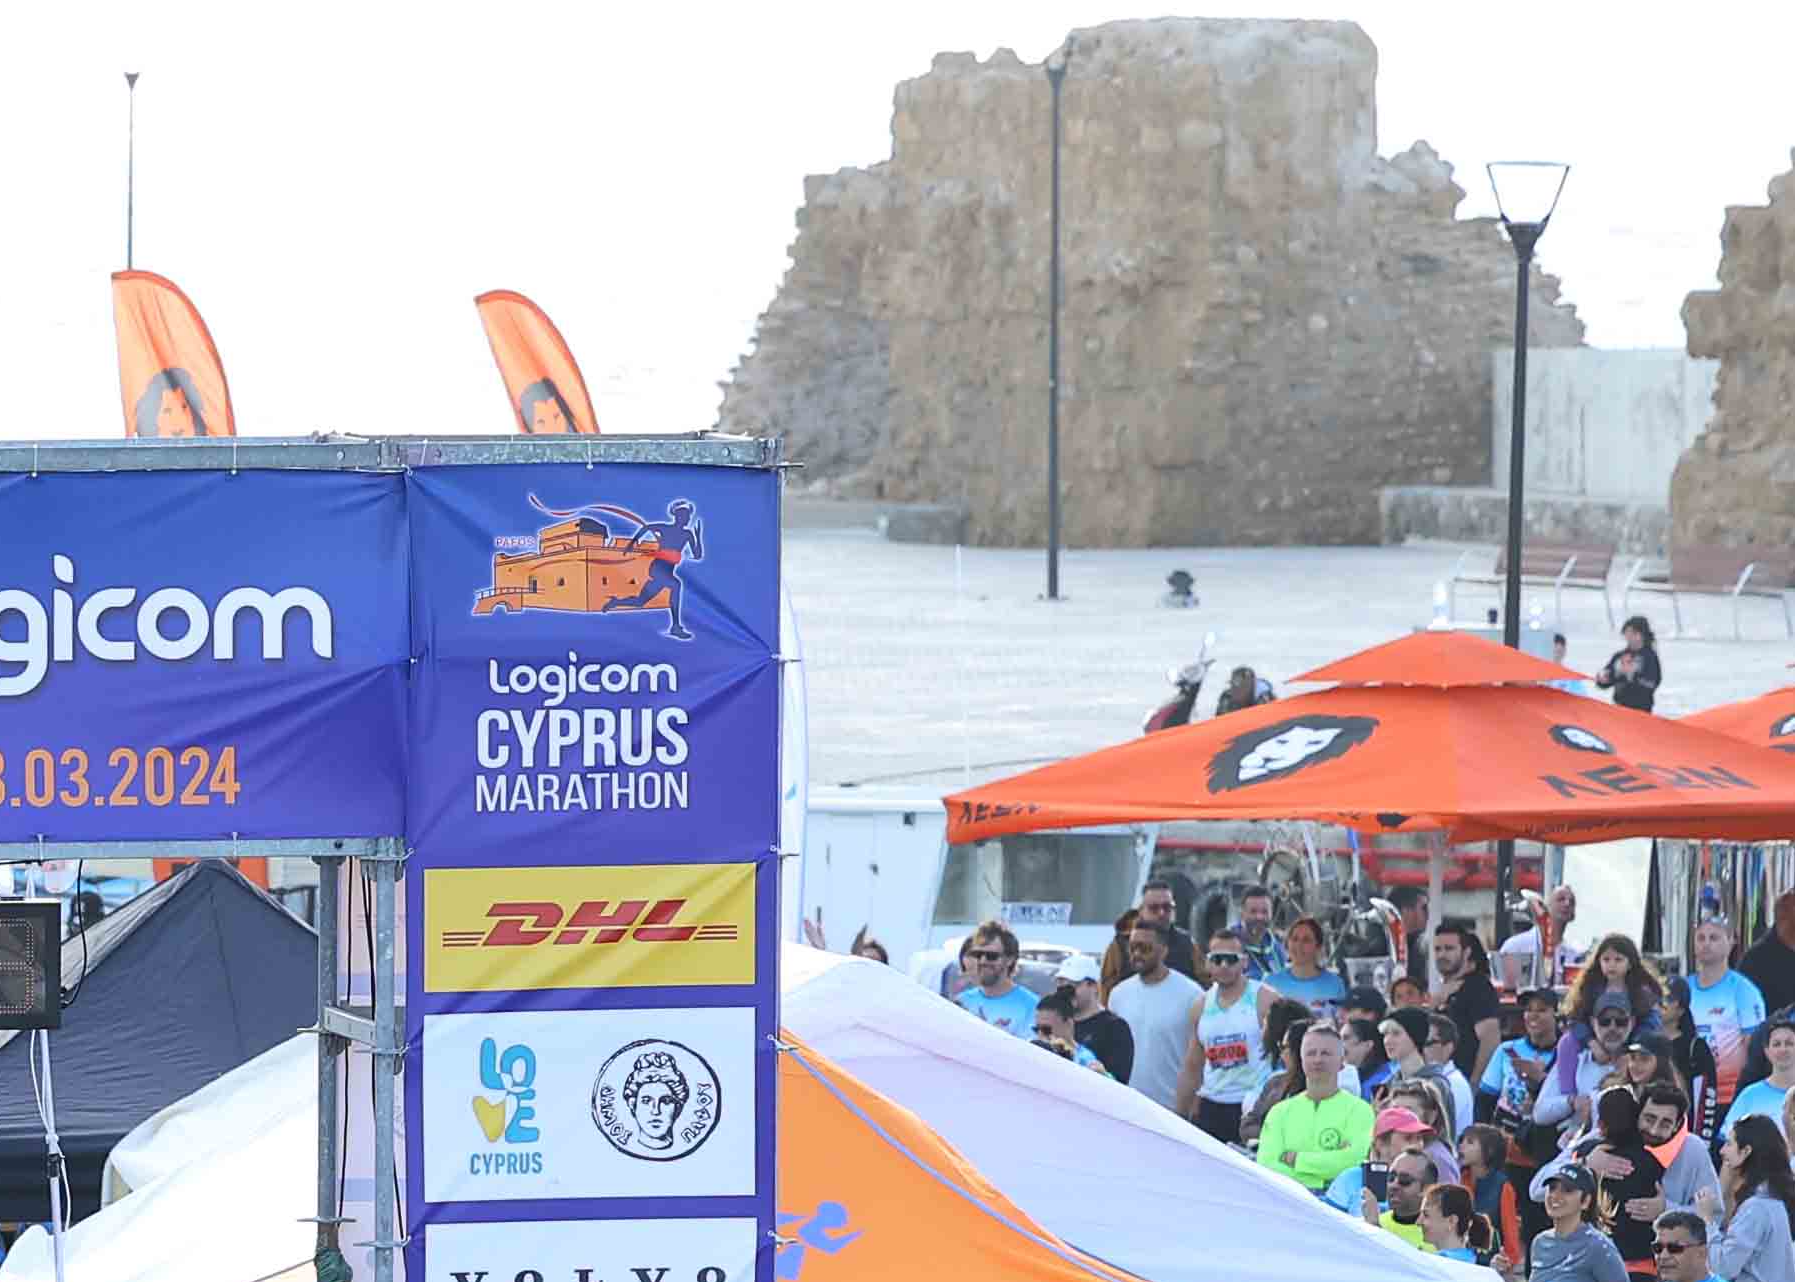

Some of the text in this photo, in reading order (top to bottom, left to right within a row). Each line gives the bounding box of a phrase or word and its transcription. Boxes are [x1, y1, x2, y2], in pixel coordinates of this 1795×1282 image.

[489, 651, 679, 707] Logicom
[475, 707, 690, 769] CYPRUS
[475, 772, 690, 813] MARATHON
[480, 899, 702, 947] DHL
[469, 1152, 543, 1176] CYPRUS
